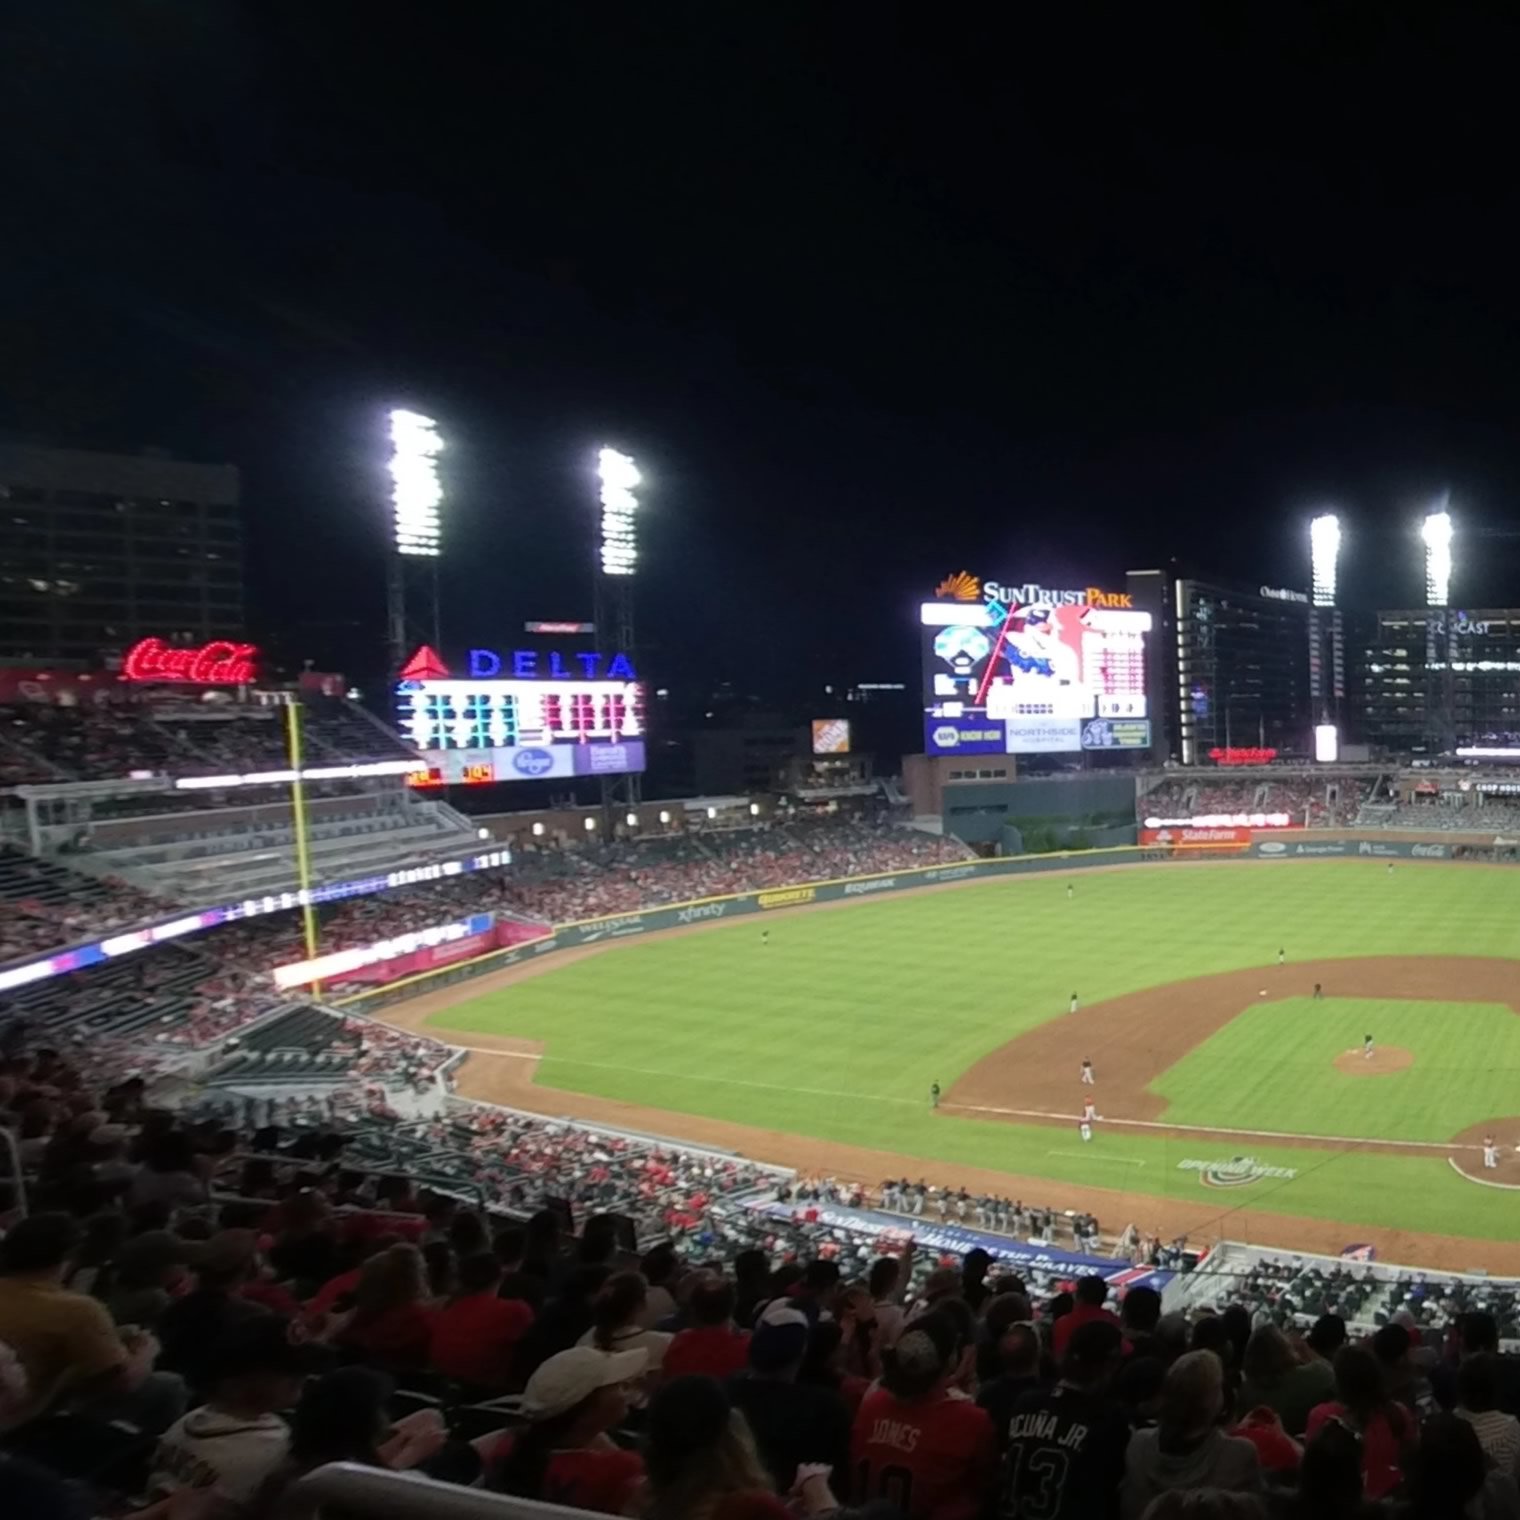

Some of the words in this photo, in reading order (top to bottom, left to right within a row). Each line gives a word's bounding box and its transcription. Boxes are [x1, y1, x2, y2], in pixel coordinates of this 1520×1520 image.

[468, 650, 637, 679] DELTA
[1009, 728, 1077, 737] NORTHSIDE
[1476, 784, 1498, 792] CHOP
[1182, 830, 1208, 841] State
[1210, 830, 1237, 840] Farm
[677, 903, 726, 922] xfinity
[921, 1232, 976, 1254] HOME
[867, 1418, 922, 1453] JONES
[997, 1442, 1071, 1520] 13
